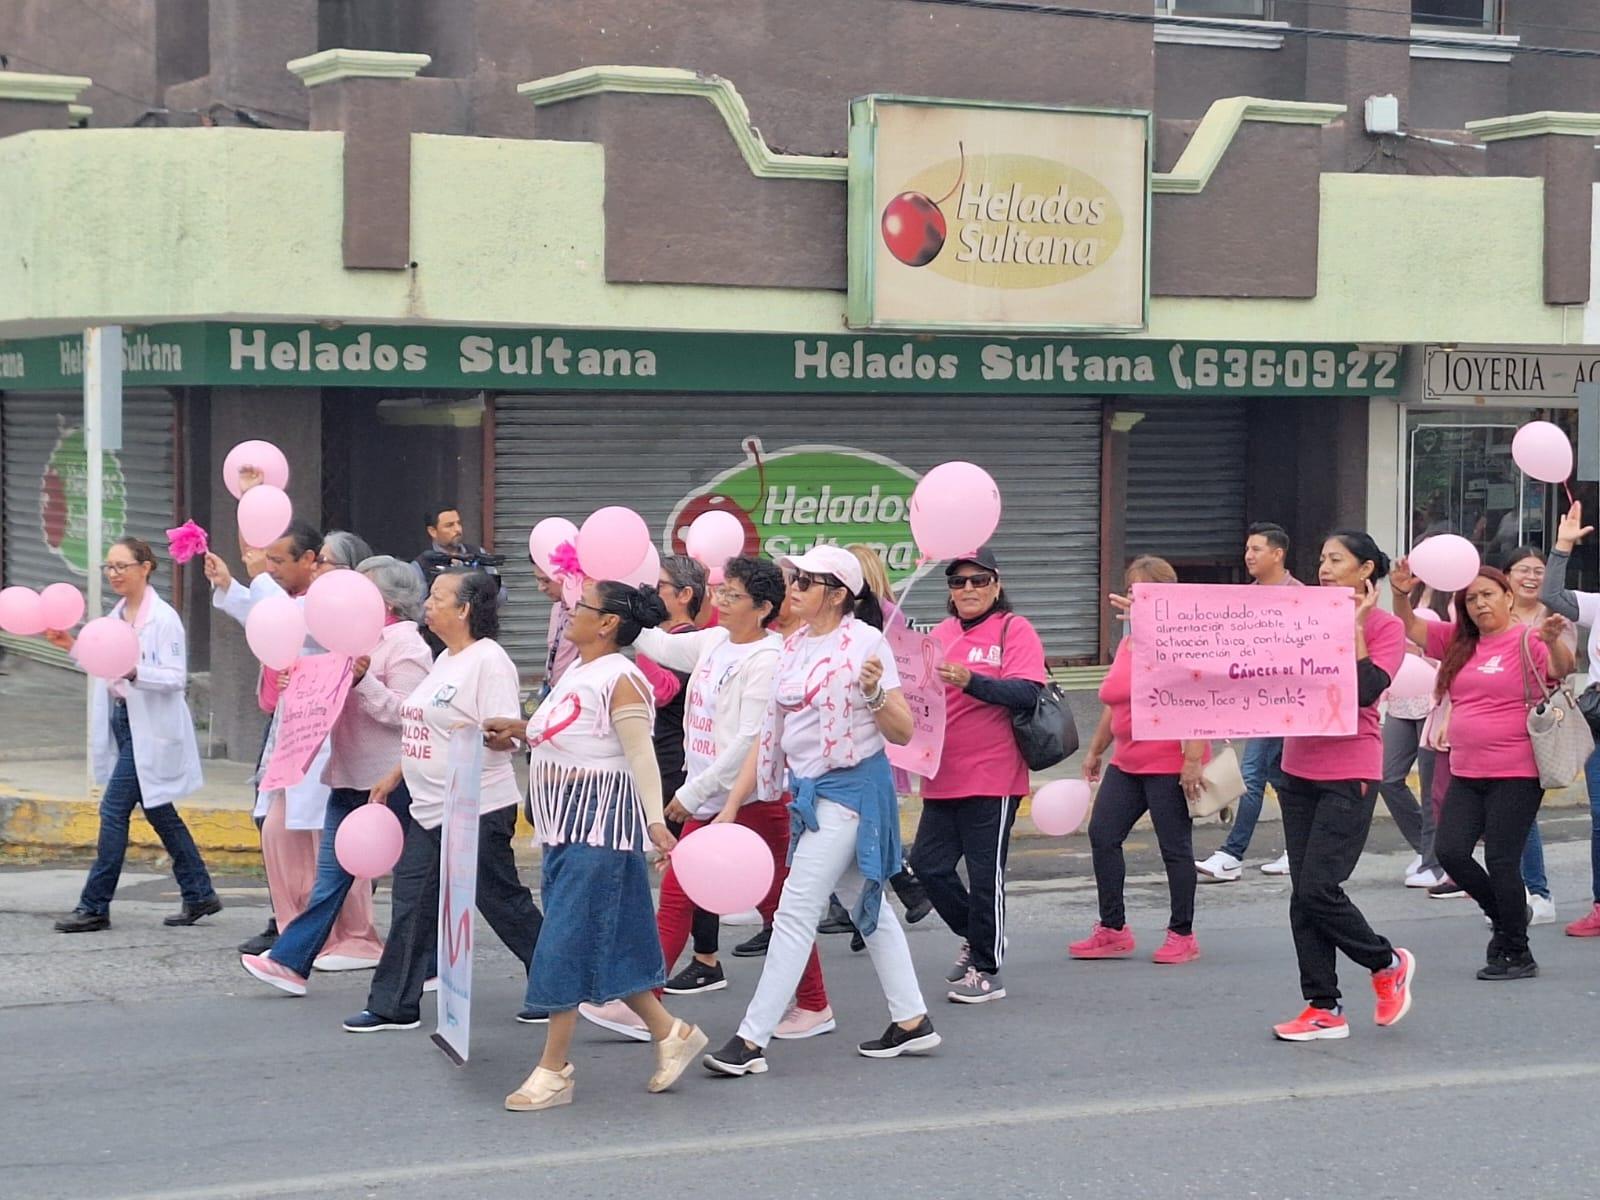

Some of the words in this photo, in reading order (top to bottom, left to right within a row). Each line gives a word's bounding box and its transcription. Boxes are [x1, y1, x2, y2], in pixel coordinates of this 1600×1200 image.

[957, 182, 1105, 226] Helados
[955, 222, 1100, 266] Sultana
[228, 328, 428, 372] Helados
[459, 335, 657, 376] Sultana
[793, 339, 959, 380] Helados
[980, 343, 1155, 383] Sultana
[1443, 352, 1545, 394] JOYERIA
[1155, 598, 1169, 621] El
[1261, 609, 1283, 617] una
[1230, 619, 1286, 631] saludable
[1294, 620, 1303, 631] y
[1308, 615, 1319, 626] la
[1156, 649, 1167, 662] la
[1239, 647, 1257, 658] del
[1209, 690, 1236, 706] Toco
[1242, 696, 1250, 711] y
[1257, 687, 1297, 707] Siento
